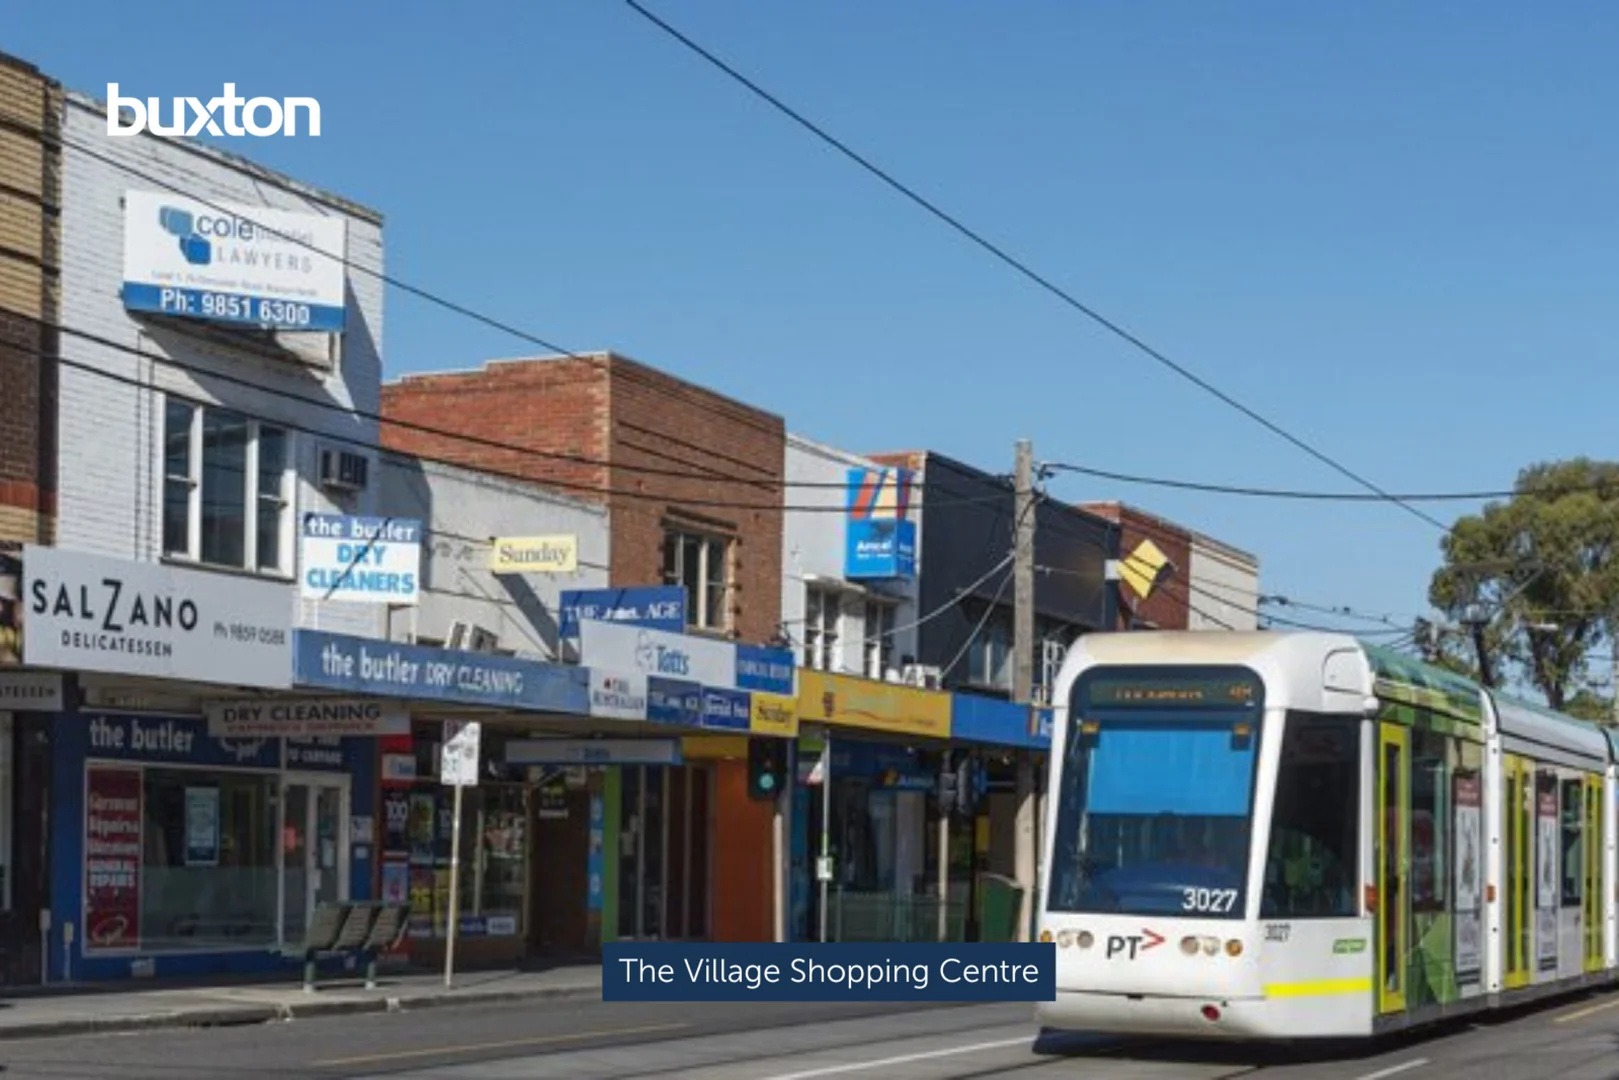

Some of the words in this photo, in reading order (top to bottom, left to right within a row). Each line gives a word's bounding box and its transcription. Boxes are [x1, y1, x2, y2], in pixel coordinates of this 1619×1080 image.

[196, 214, 254, 242] cole
[216, 245, 313, 274] LAWYERS
[160, 287, 195, 311] Ph:
[202, 293, 251, 318] 9851
[259, 300, 310, 325] 6300
[308, 516, 342, 537] the
[500, 542, 571, 566] Sunday
[306, 568, 415, 595] CLEANERS
[32, 578, 199, 632] SALZANO
[61, 630, 173, 657] DELICATESSEN
[321, 643, 355, 677] the
[360, 646, 419, 686] butler
[425, 661, 453, 686] DRY
[456, 664, 524, 694] CLEANING
[223, 705, 263, 723] DRY
[269, 702, 381, 722] CLEANING
[89, 717, 125, 748] the
[130, 717, 195, 752] butler
[1182, 887, 1238, 914] 3027
[1106, 935, 1144, 961] PT
